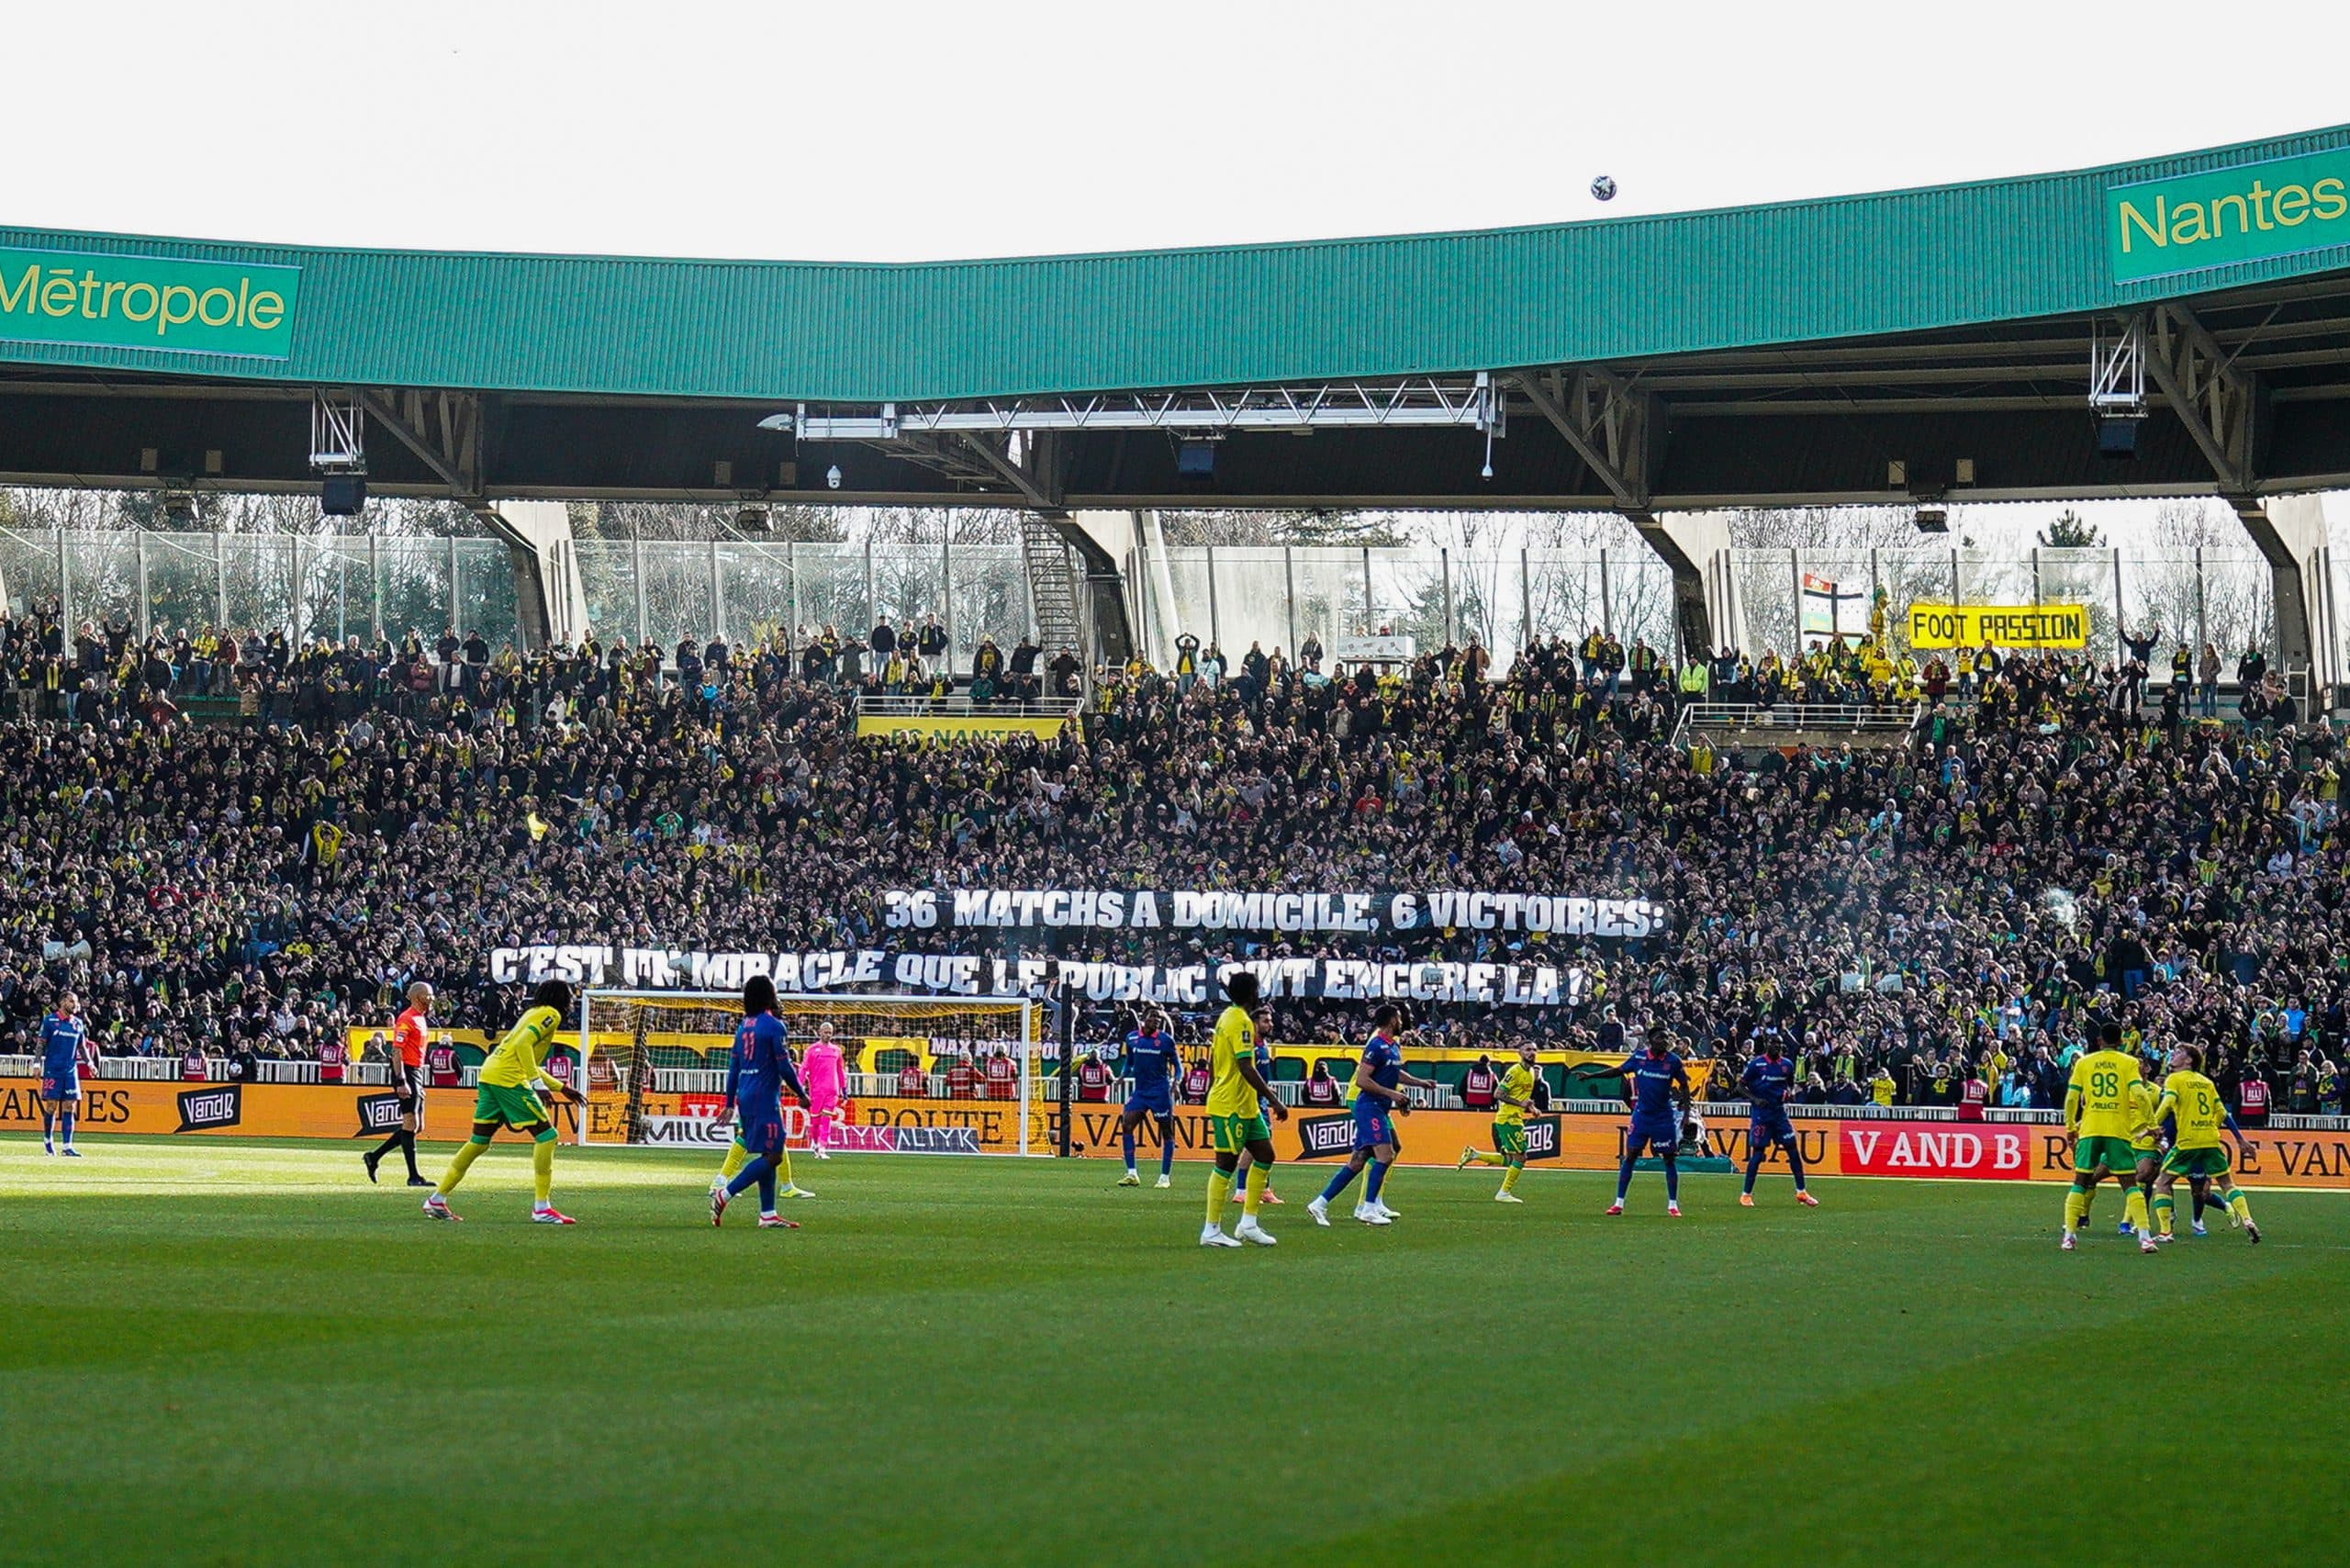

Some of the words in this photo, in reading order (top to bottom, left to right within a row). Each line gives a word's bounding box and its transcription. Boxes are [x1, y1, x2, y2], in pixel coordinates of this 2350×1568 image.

[2120, 178, 2348, 253] Nantes
[1913, 613, 1967, 640] FOOT
[1980, 612, 2081, 641] PASSION
[885, 890, 937, 928] 36
[954, 890, 1125, 928] MATCHS
[1130, 890, 1161, 928] A
[1391, 893, 1418, 929] 6
[490, 945, 614, 985] C'EST
[690, 950, 886, 991] MIRACLE
[894, 953, 980, 995] QUE
[991, 958, 1047, 998] LE
[1058, 960, 1207, 1003] PUBLIC
[2091, 1072, 2119, 1098] 98
[0, 1087, 130, 1124] ANES
[2198, 1092, 2210, 1116] 8
[648, 1120, 738, 1144] MILLE
[827, 1126, 896, 1151] LTYK
[1080, 1113, 1217, 1149] VANNE
[1236, 1122, 1243, 1138] 6
[1848, 1130, 1881, 1166] V
[1886, 1131, 1983, 1169] AND
[1992, 1133, 2023, 1170] B
